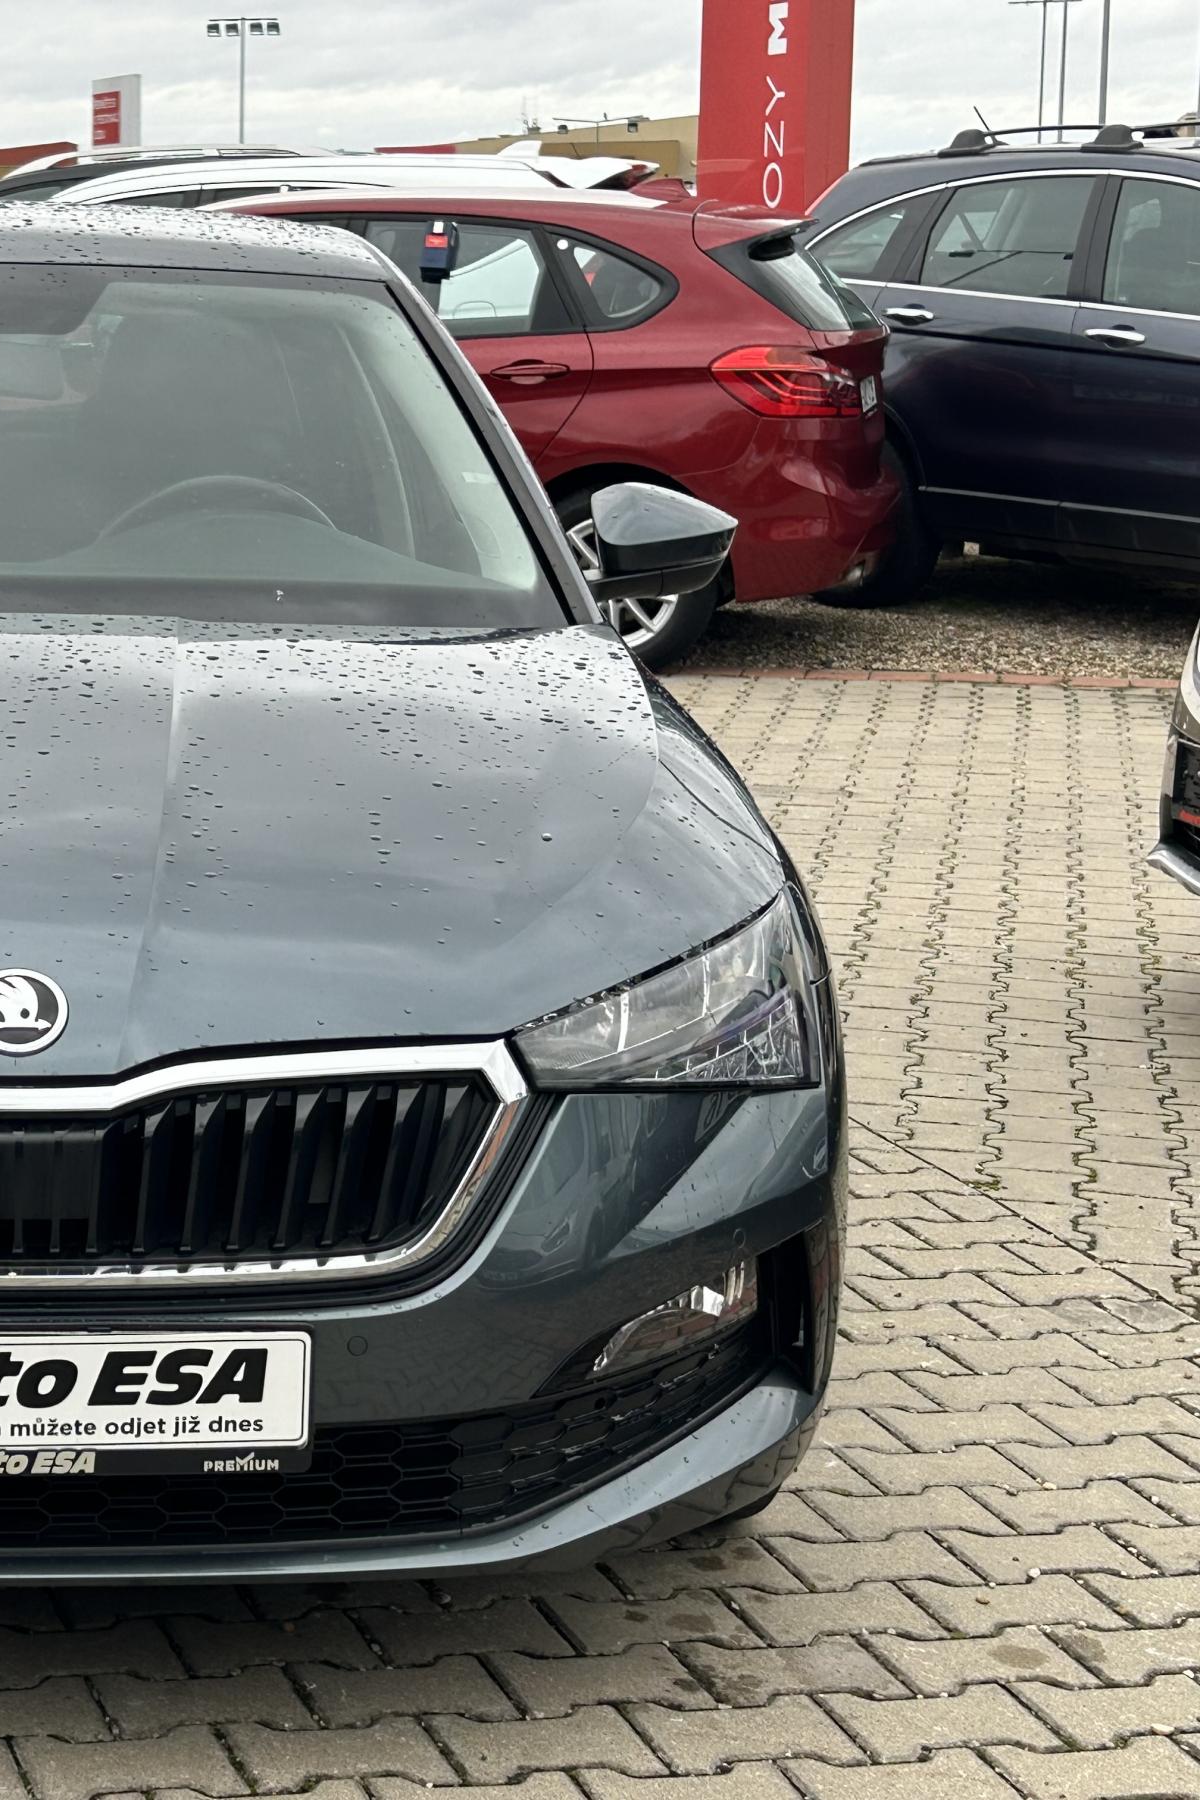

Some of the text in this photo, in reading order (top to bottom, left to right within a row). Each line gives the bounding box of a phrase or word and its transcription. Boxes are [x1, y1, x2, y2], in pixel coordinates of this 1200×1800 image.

[87, 1348, 270, 1407] ESA
[10, 1417, 97, 1437] můžete
[104, 1417, 167, 1437] odjet
[173, 1415, 201, 1438] již
[208, 1415, 264, 1433] dnes
[30, 1450, 96, 1475] ESA
[203, 1452, 280, 1473] PREMIUM
